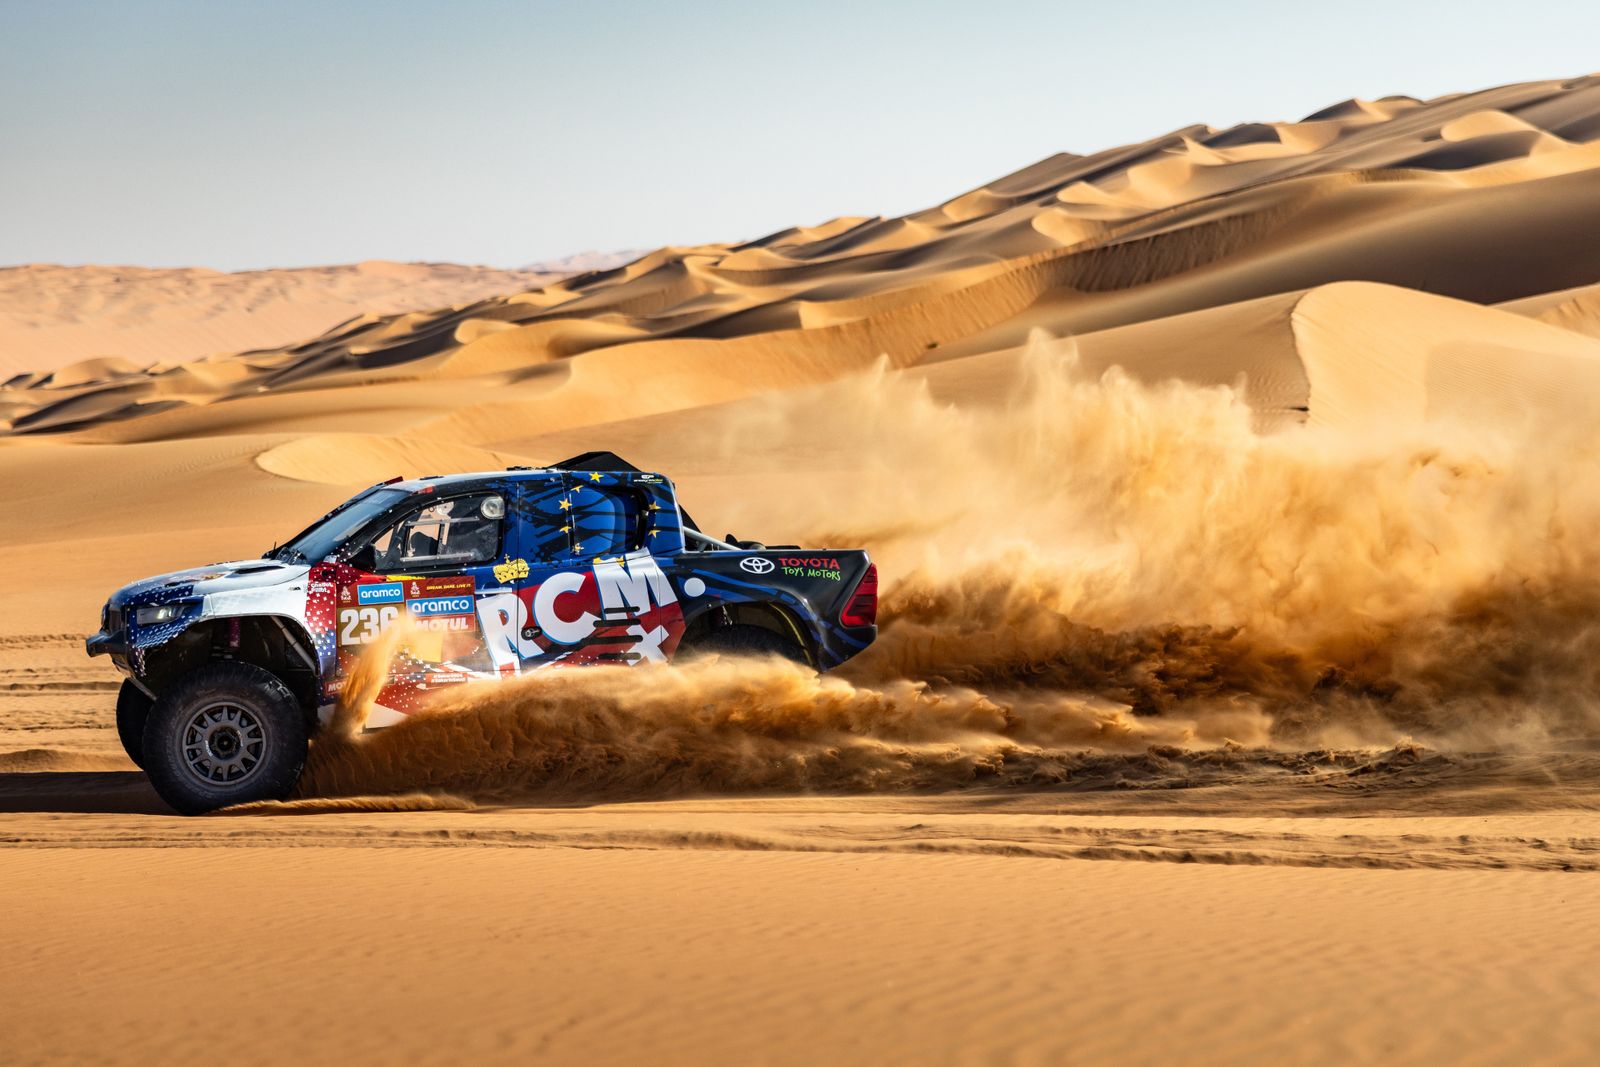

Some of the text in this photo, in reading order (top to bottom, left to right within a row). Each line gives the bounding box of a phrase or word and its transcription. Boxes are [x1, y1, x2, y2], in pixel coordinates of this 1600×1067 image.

[778, 558, 840, 570] TOYOTA
[781, 566, 841, 581] TOYS MOTORS
[361, 589, 401, 598] aramco
[411, 599, 469, 613] aramco
[340, 606, 399, 645] 236
[416, 617, 469, 631] MOTUL
